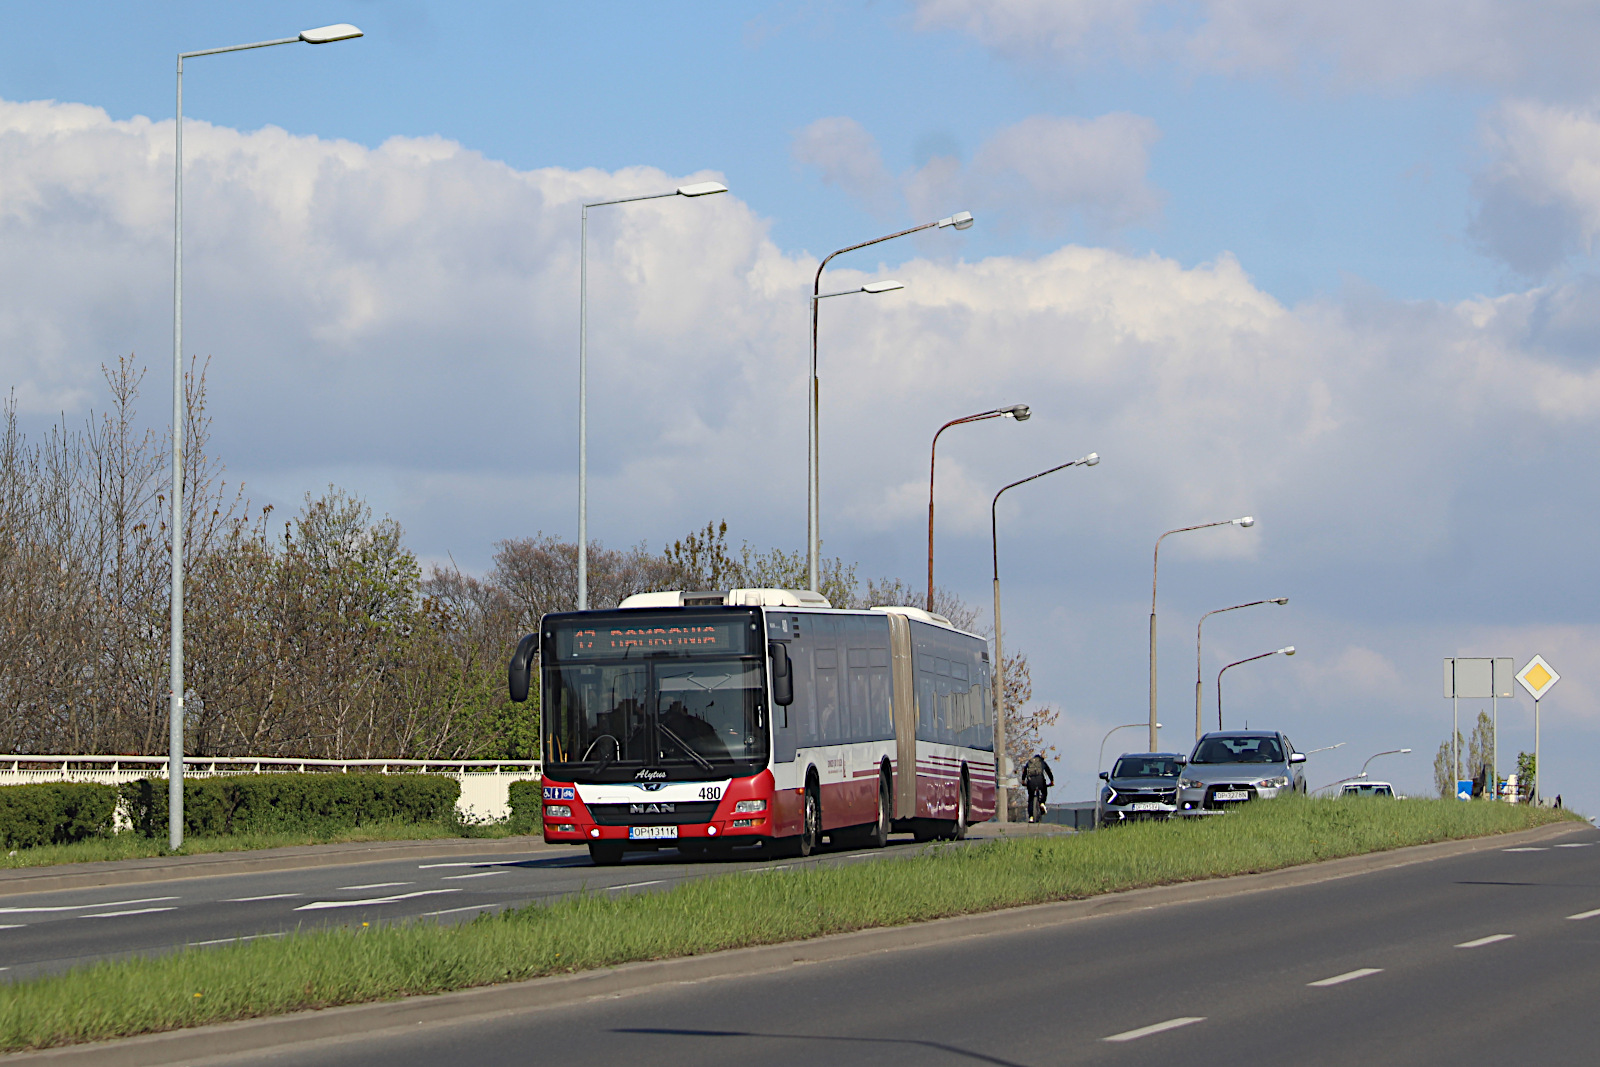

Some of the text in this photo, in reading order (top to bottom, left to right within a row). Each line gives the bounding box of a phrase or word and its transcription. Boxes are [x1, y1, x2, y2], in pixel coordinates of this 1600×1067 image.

[634, 769, 666, 780] Alytus
[698, 787, 721, 800] 480
[629, 803, 675, 814] MAN
